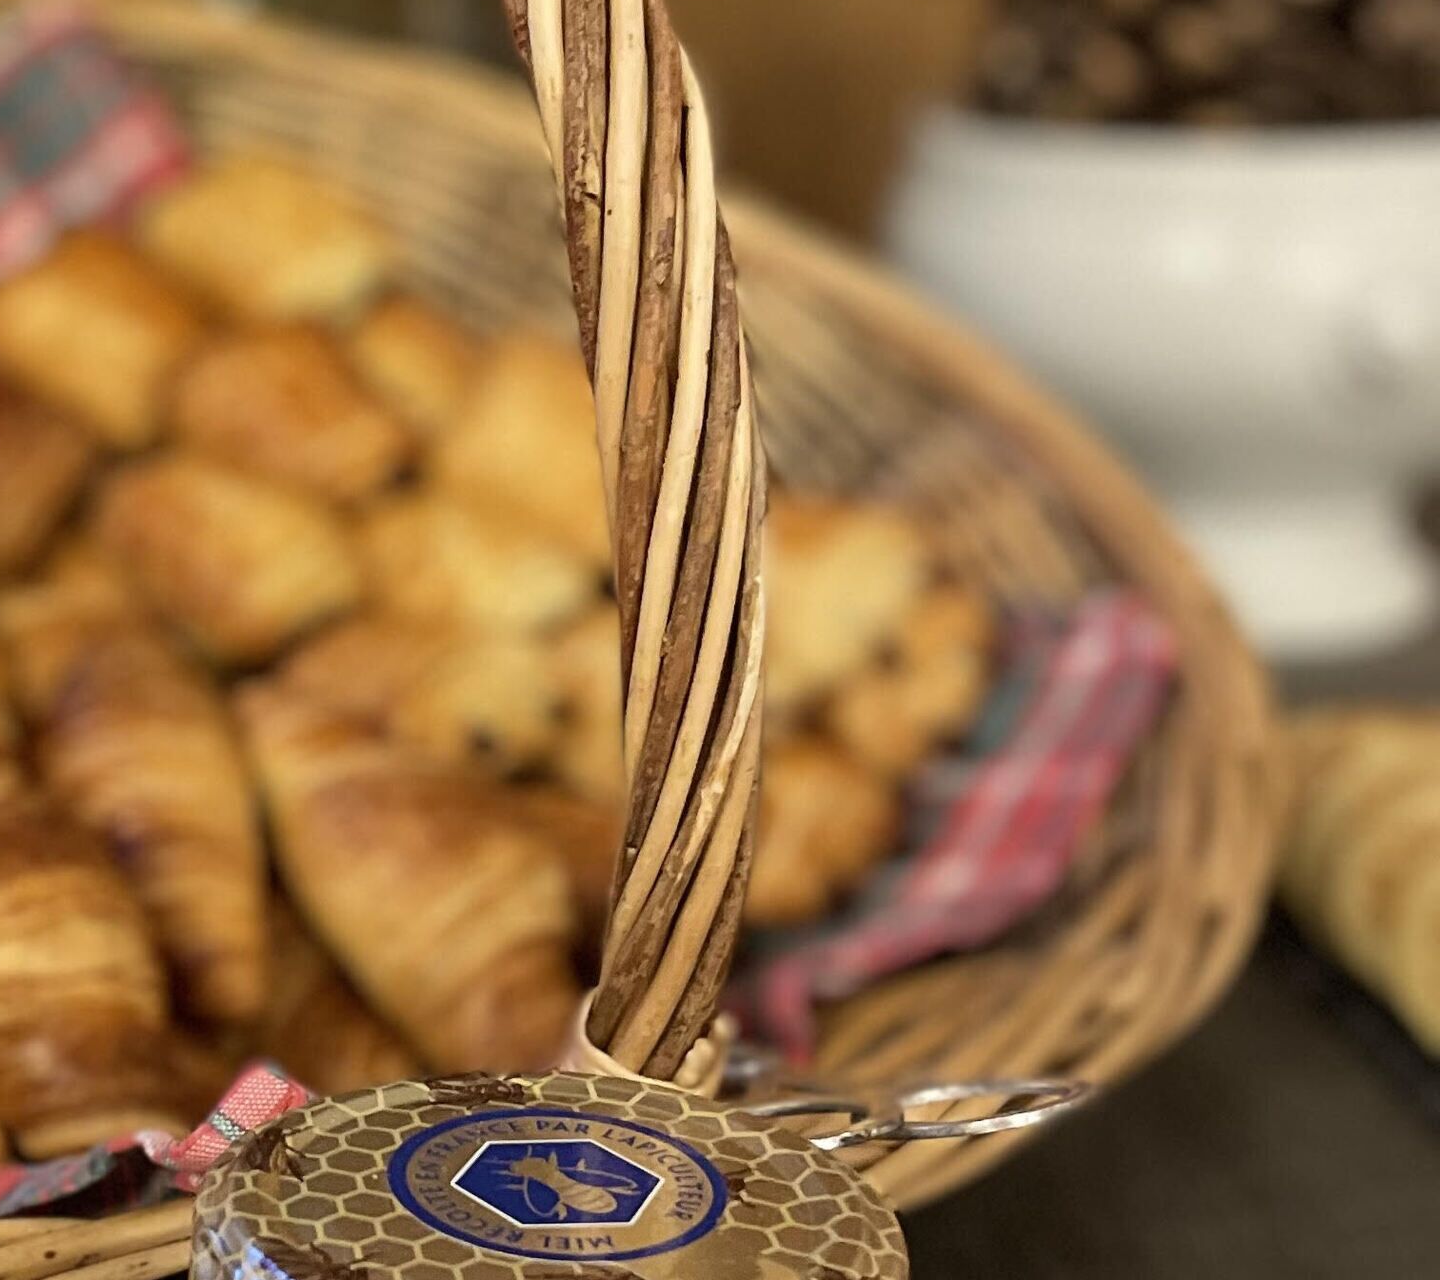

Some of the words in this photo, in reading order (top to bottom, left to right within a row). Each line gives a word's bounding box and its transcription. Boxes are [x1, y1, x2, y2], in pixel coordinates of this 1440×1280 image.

[535, 1119, 590, 1135] PAR
[426, 1121, 525, 1159] FRANCE
[541, 1233, 615, 1251] MIEL
